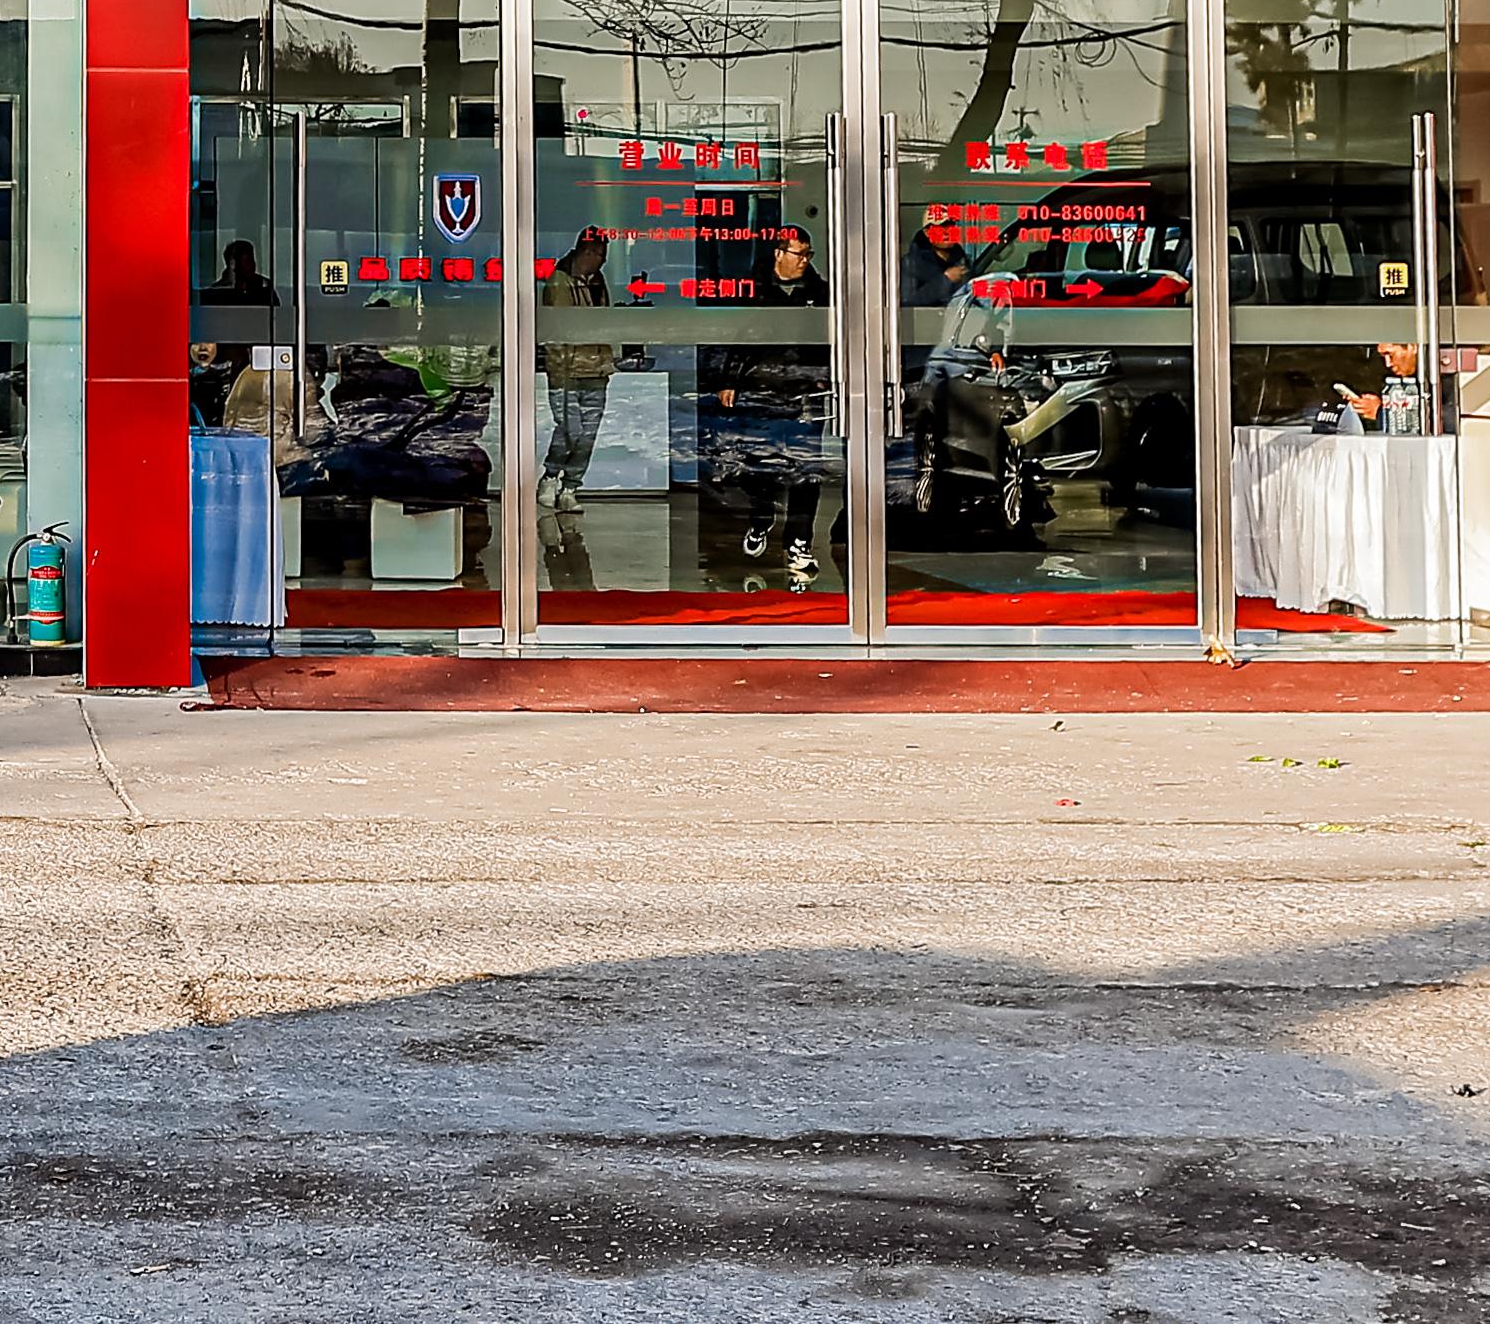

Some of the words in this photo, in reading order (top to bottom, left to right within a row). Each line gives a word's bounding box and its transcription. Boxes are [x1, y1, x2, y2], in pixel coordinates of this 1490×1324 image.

[619, 140, 760, 170] 营业时间
[965, 141, 1109, 171] 联系电话
[645, 197, 735, 217] 周一至周日
[325, 264, 344, 283] 推
[1385, 268, 1403, 285] 推
[679, 279, 755, 298] 请走侧门
[972, 279, 1047, 299] 请走侧门
